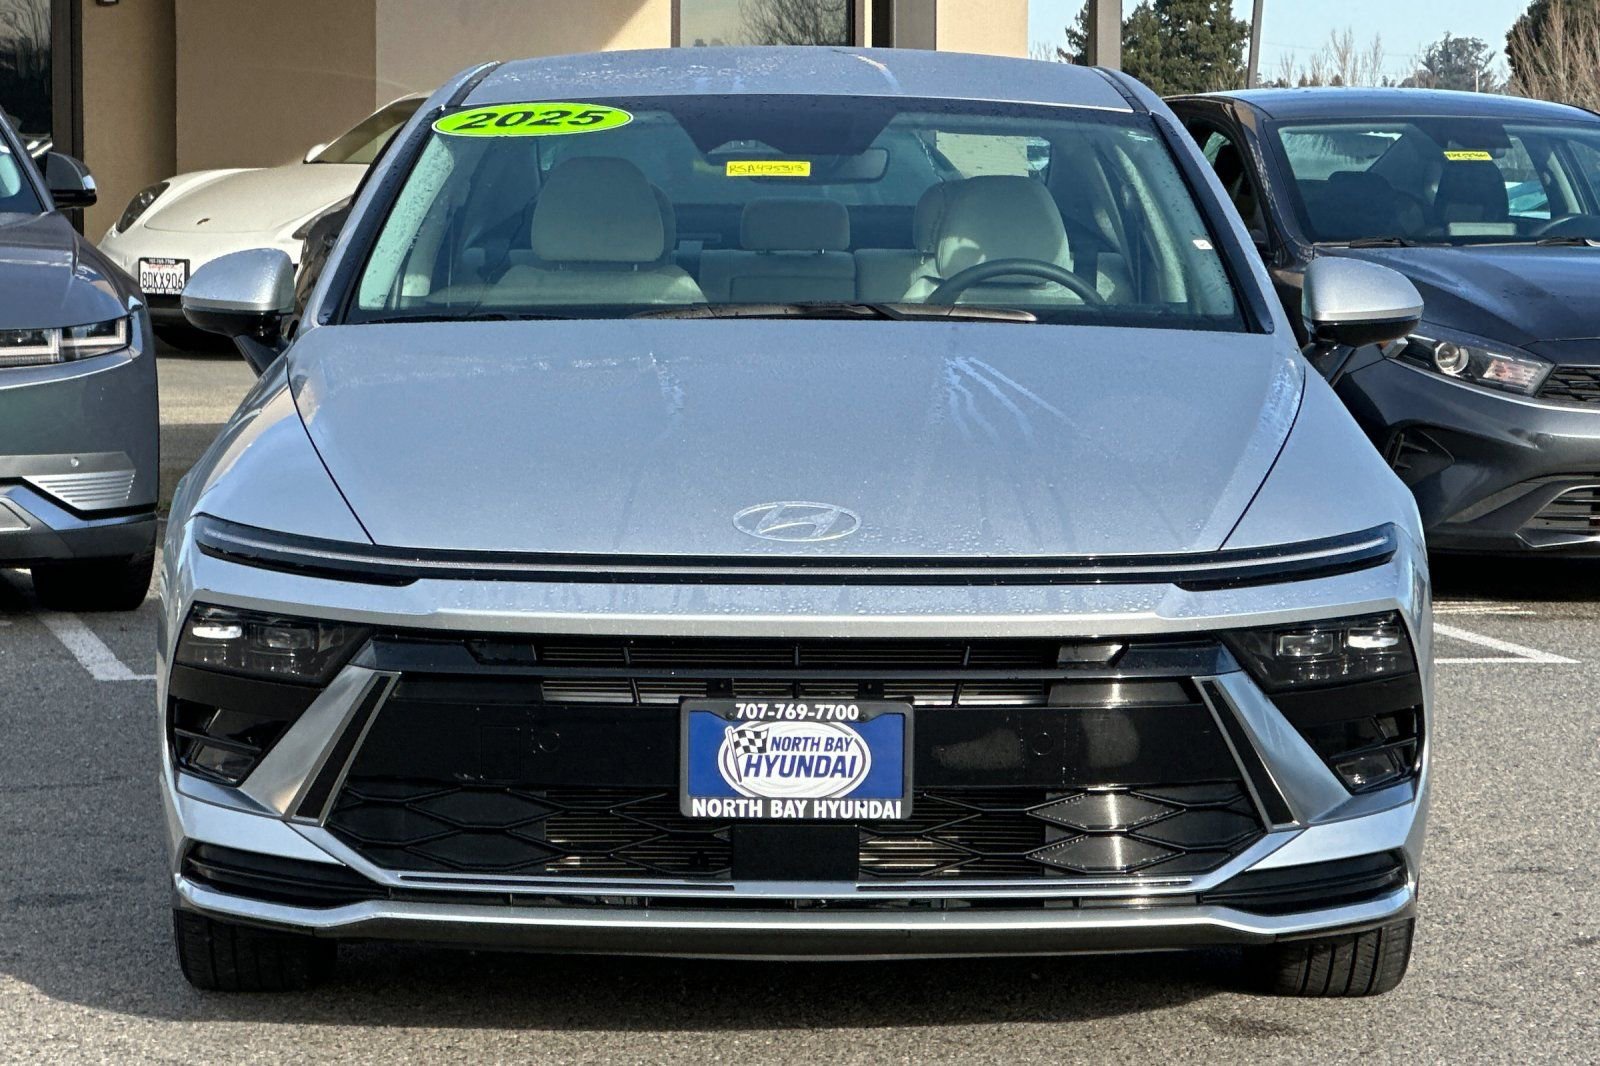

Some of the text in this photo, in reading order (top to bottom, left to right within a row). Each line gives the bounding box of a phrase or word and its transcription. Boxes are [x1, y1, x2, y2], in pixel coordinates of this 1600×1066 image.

[453, 110, 612, 130] 2025
[142, 272, 182, 289] 8DKX906
[735, 703, 859, 720] 707-769-7700
[770, 736, 854, 752] NORTH BAY
[743, 755, 857, 778] HYUNDAI
[692, 799, 901, 819] NORTH BAY HYUNDAI
